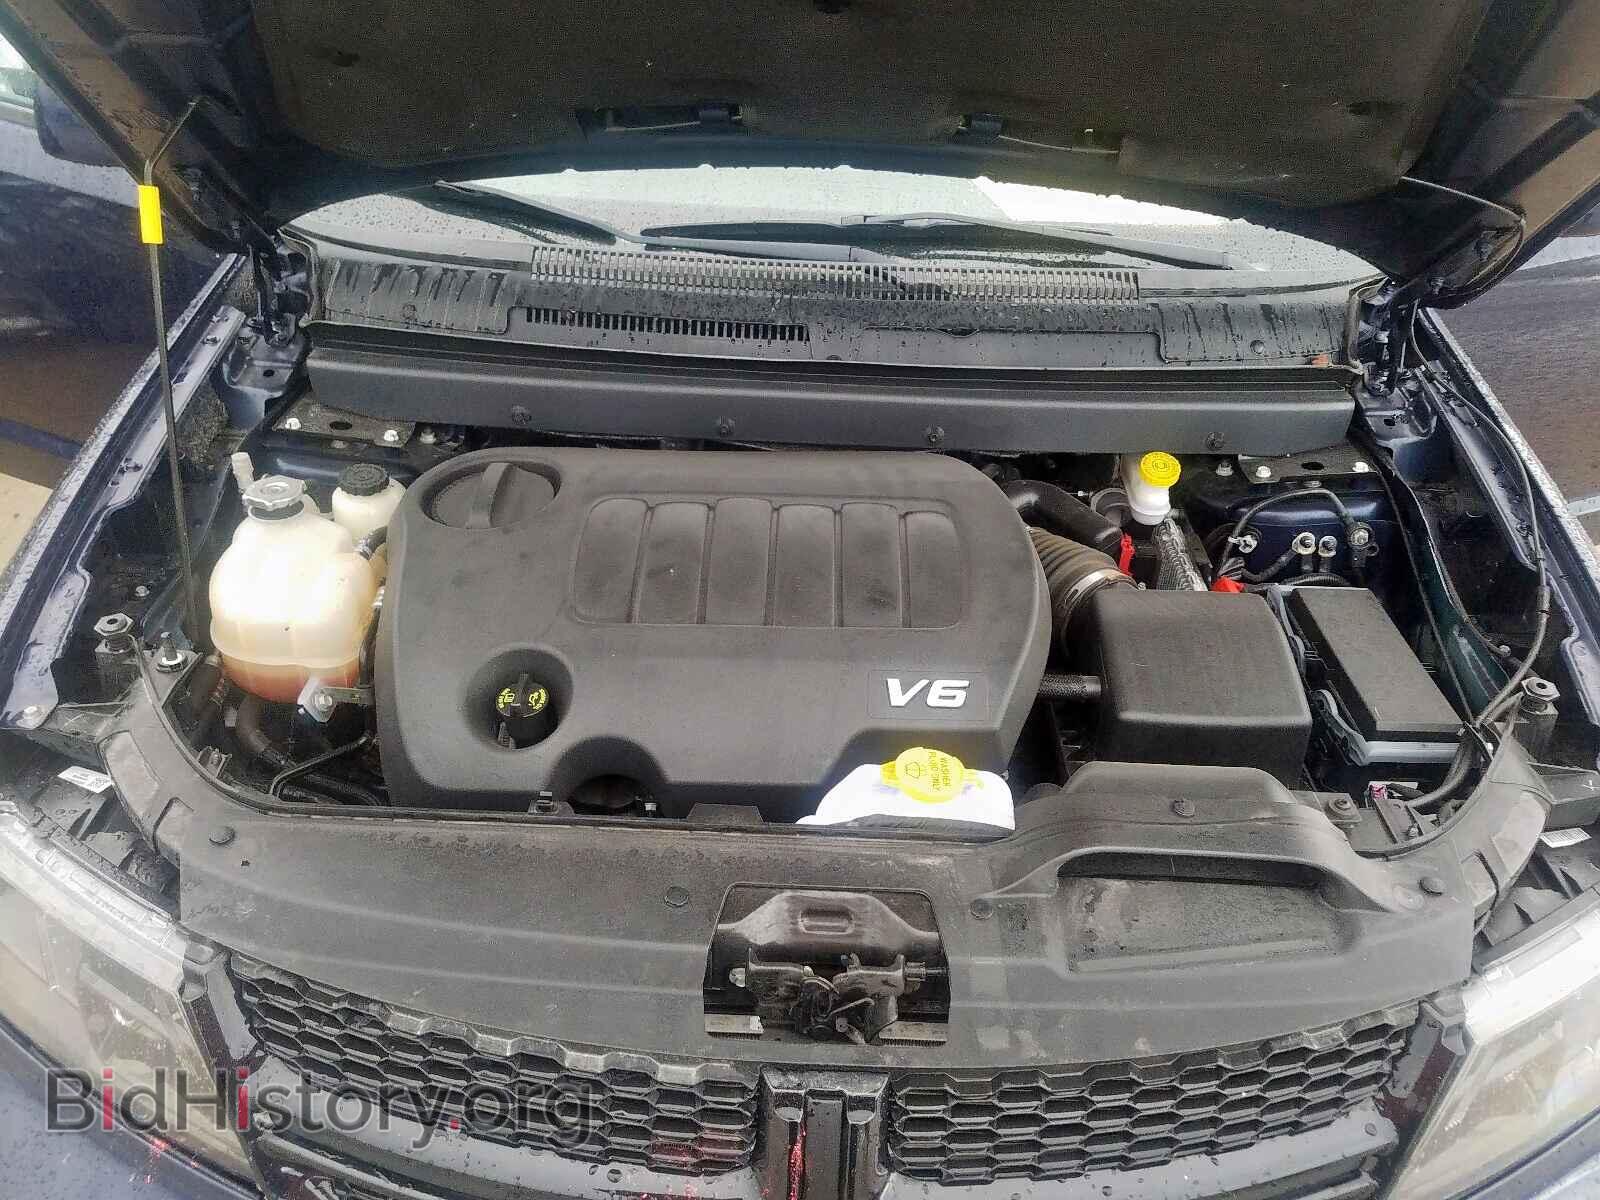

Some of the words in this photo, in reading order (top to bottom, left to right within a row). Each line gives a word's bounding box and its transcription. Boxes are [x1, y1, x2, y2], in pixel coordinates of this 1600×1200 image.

[886, 678, 970, 708] V6
[928, 751, 937, 771] FLUID
[940, 757, 951, 787] WASHER
[931, 772, 941, 791] ONLY
